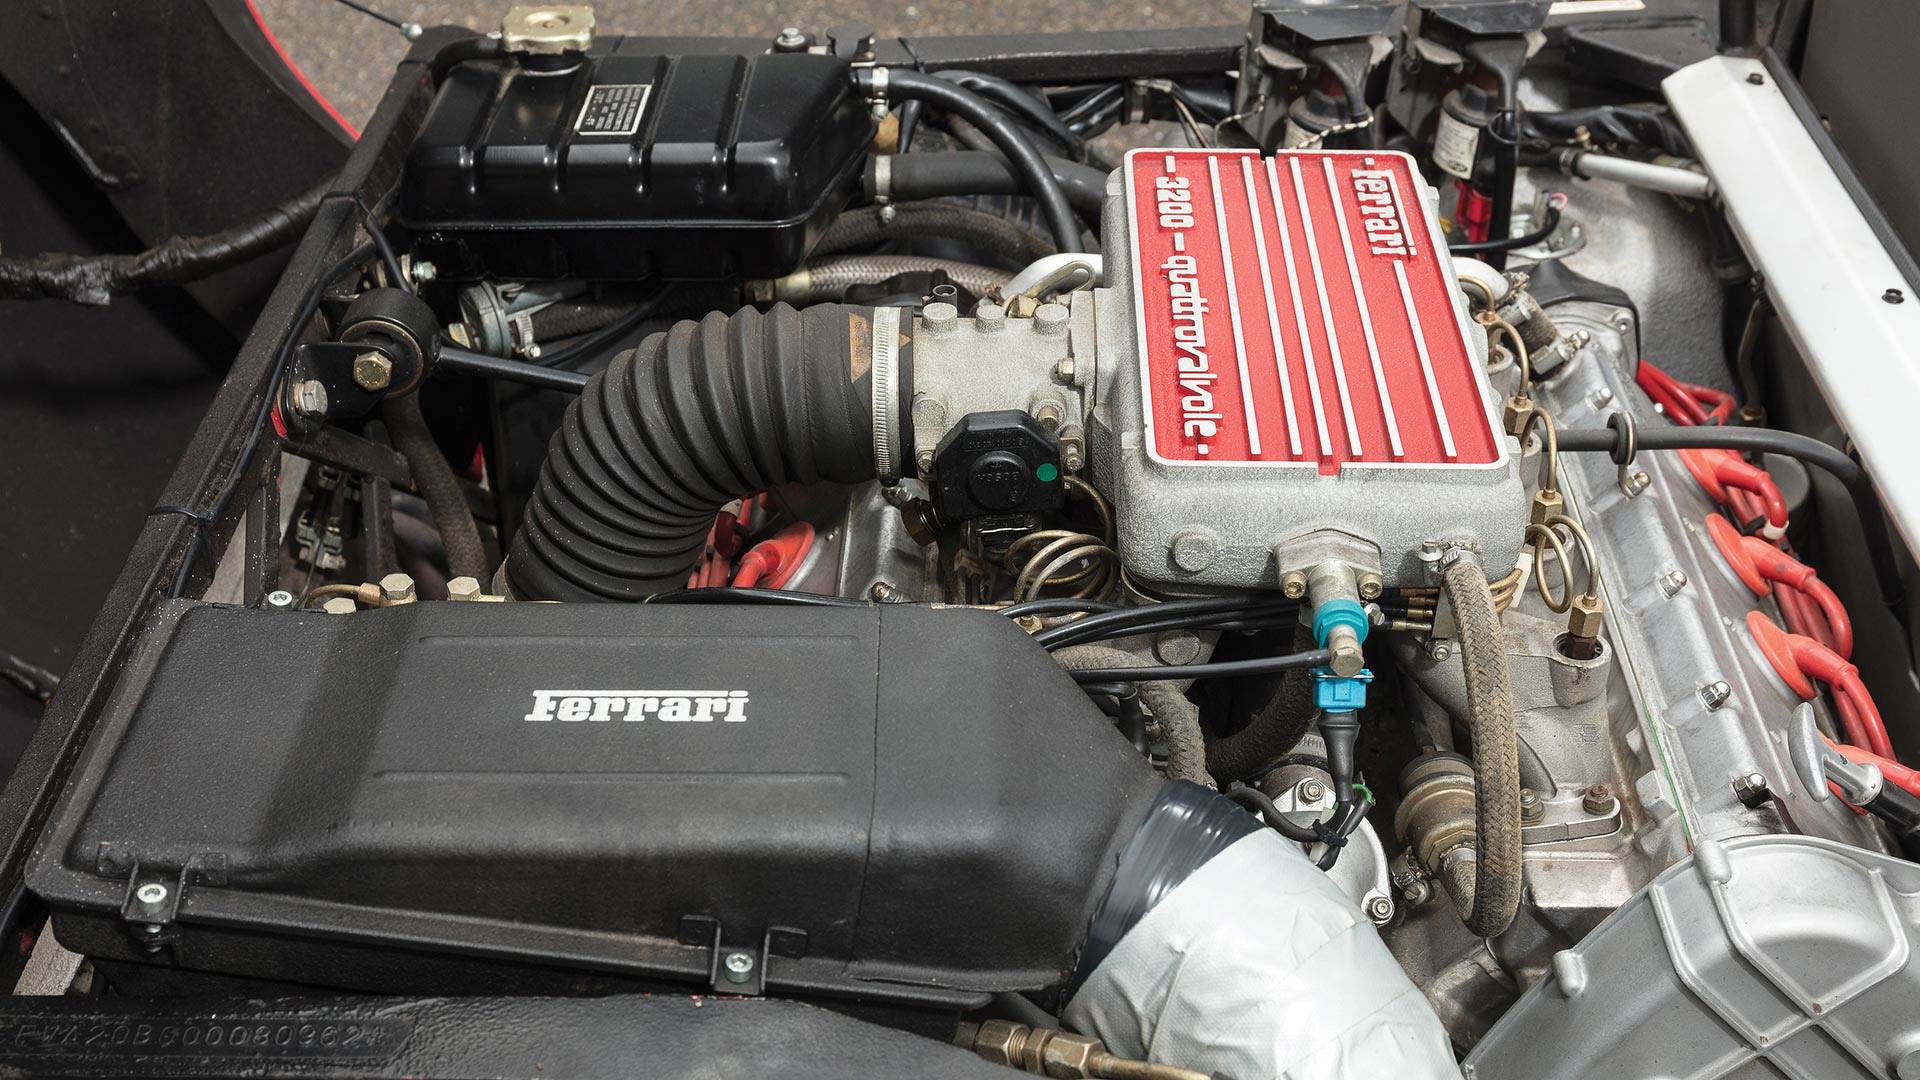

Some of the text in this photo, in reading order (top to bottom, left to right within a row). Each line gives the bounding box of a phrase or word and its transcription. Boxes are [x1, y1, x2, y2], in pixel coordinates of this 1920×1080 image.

[1351, 168, 1418, 257] Ferrari
[1155, 176, 1223, 438] 3200 quattrovalvole
[524, 690, 750, 722] Ferrari
